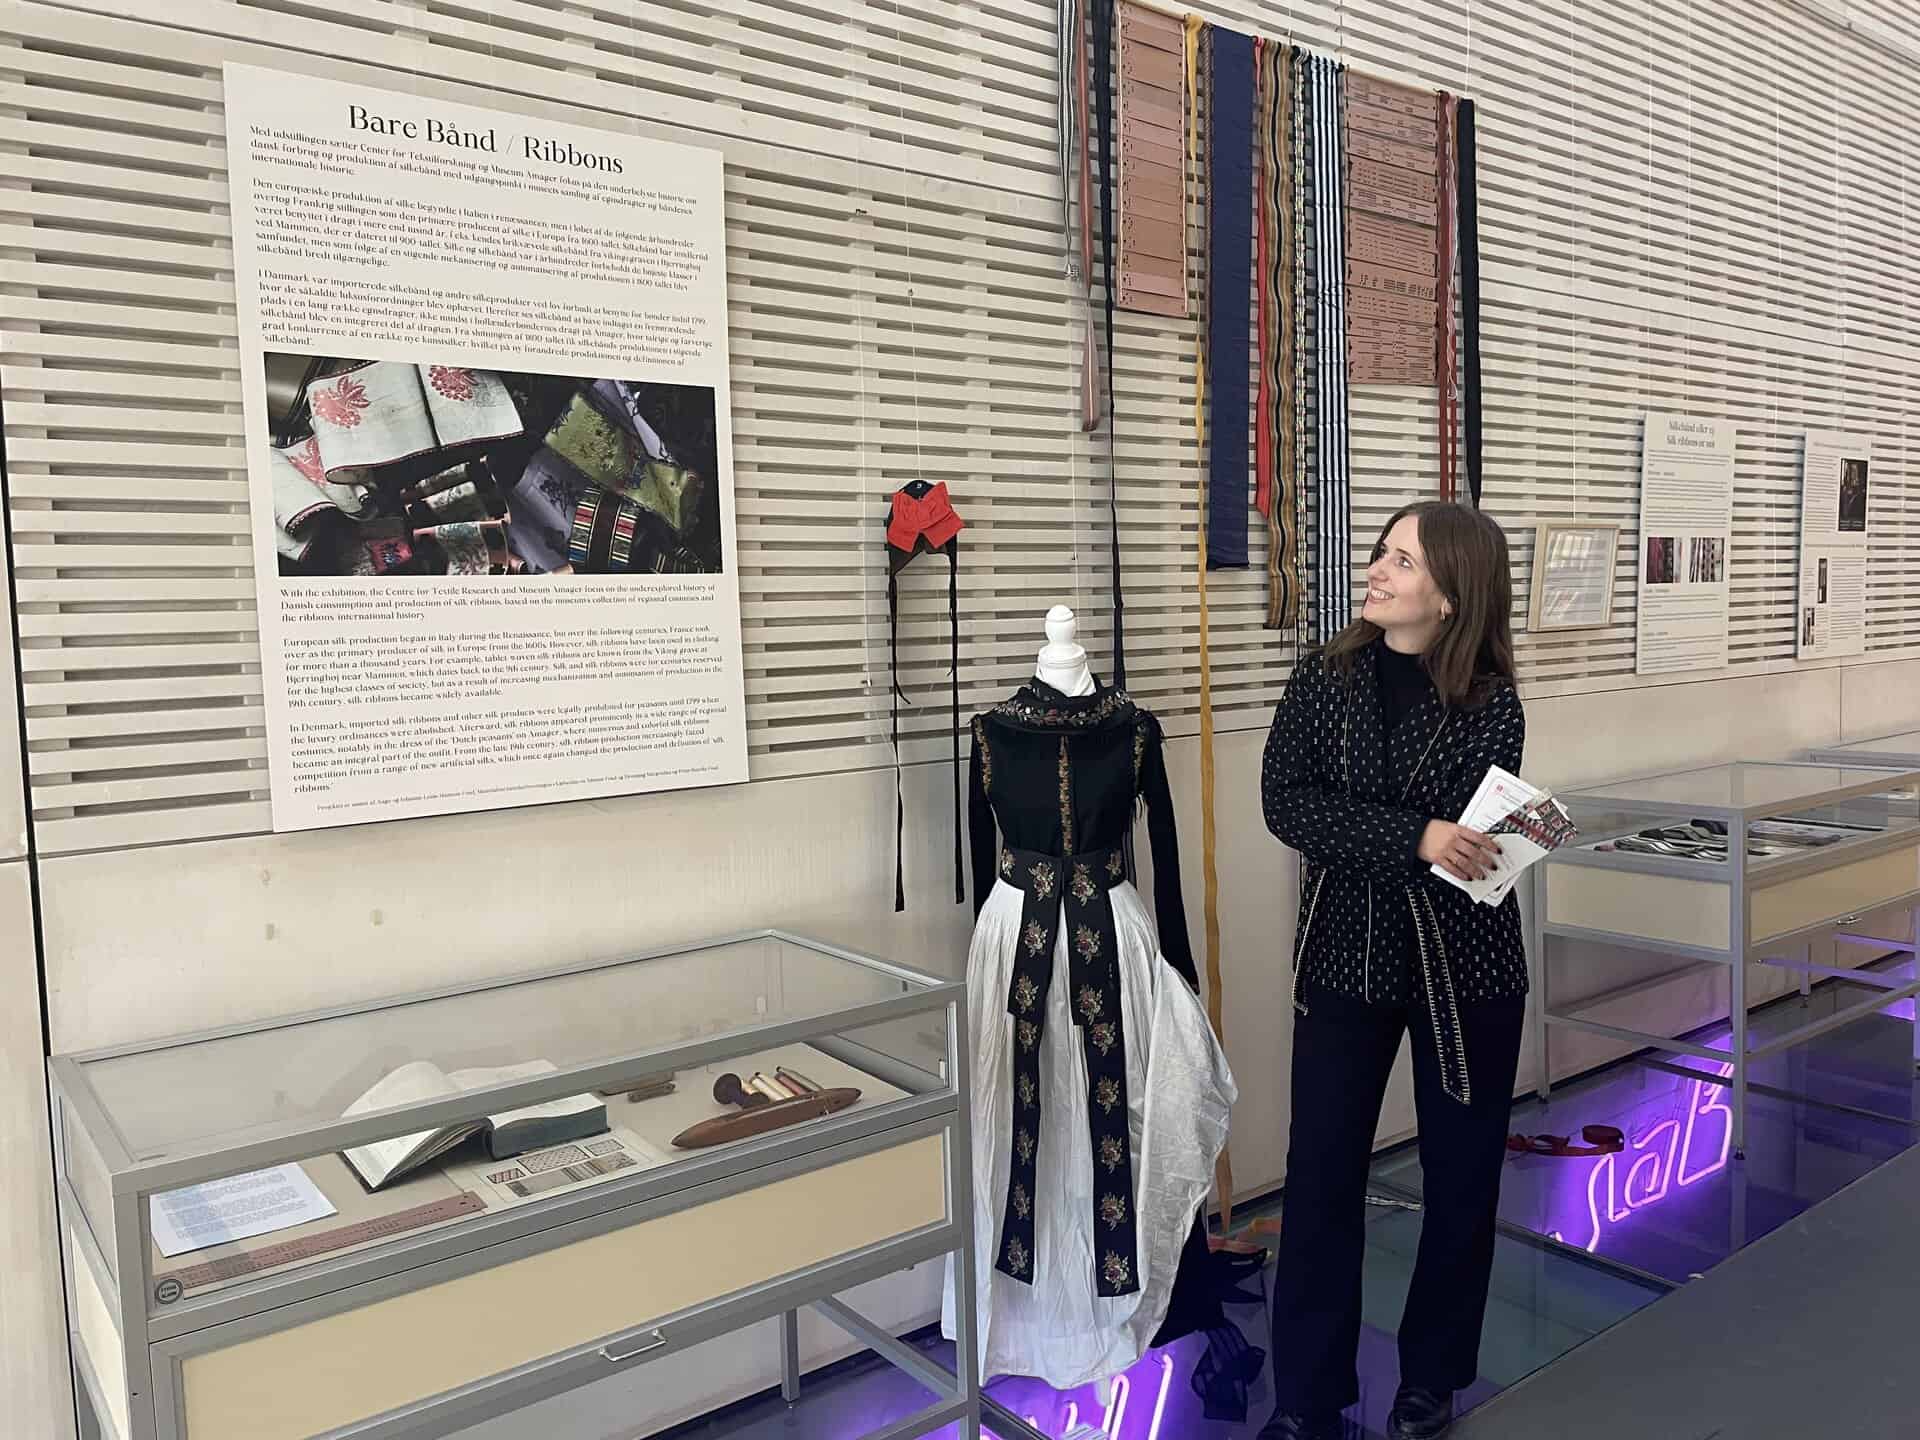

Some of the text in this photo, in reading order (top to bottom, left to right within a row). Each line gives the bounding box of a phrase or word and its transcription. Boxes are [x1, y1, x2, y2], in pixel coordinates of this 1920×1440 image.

[348, 104, 417, 138] Bare
[425, 118, 498, 152] Bånd
[523, 135, 624, 175] Ribbons
